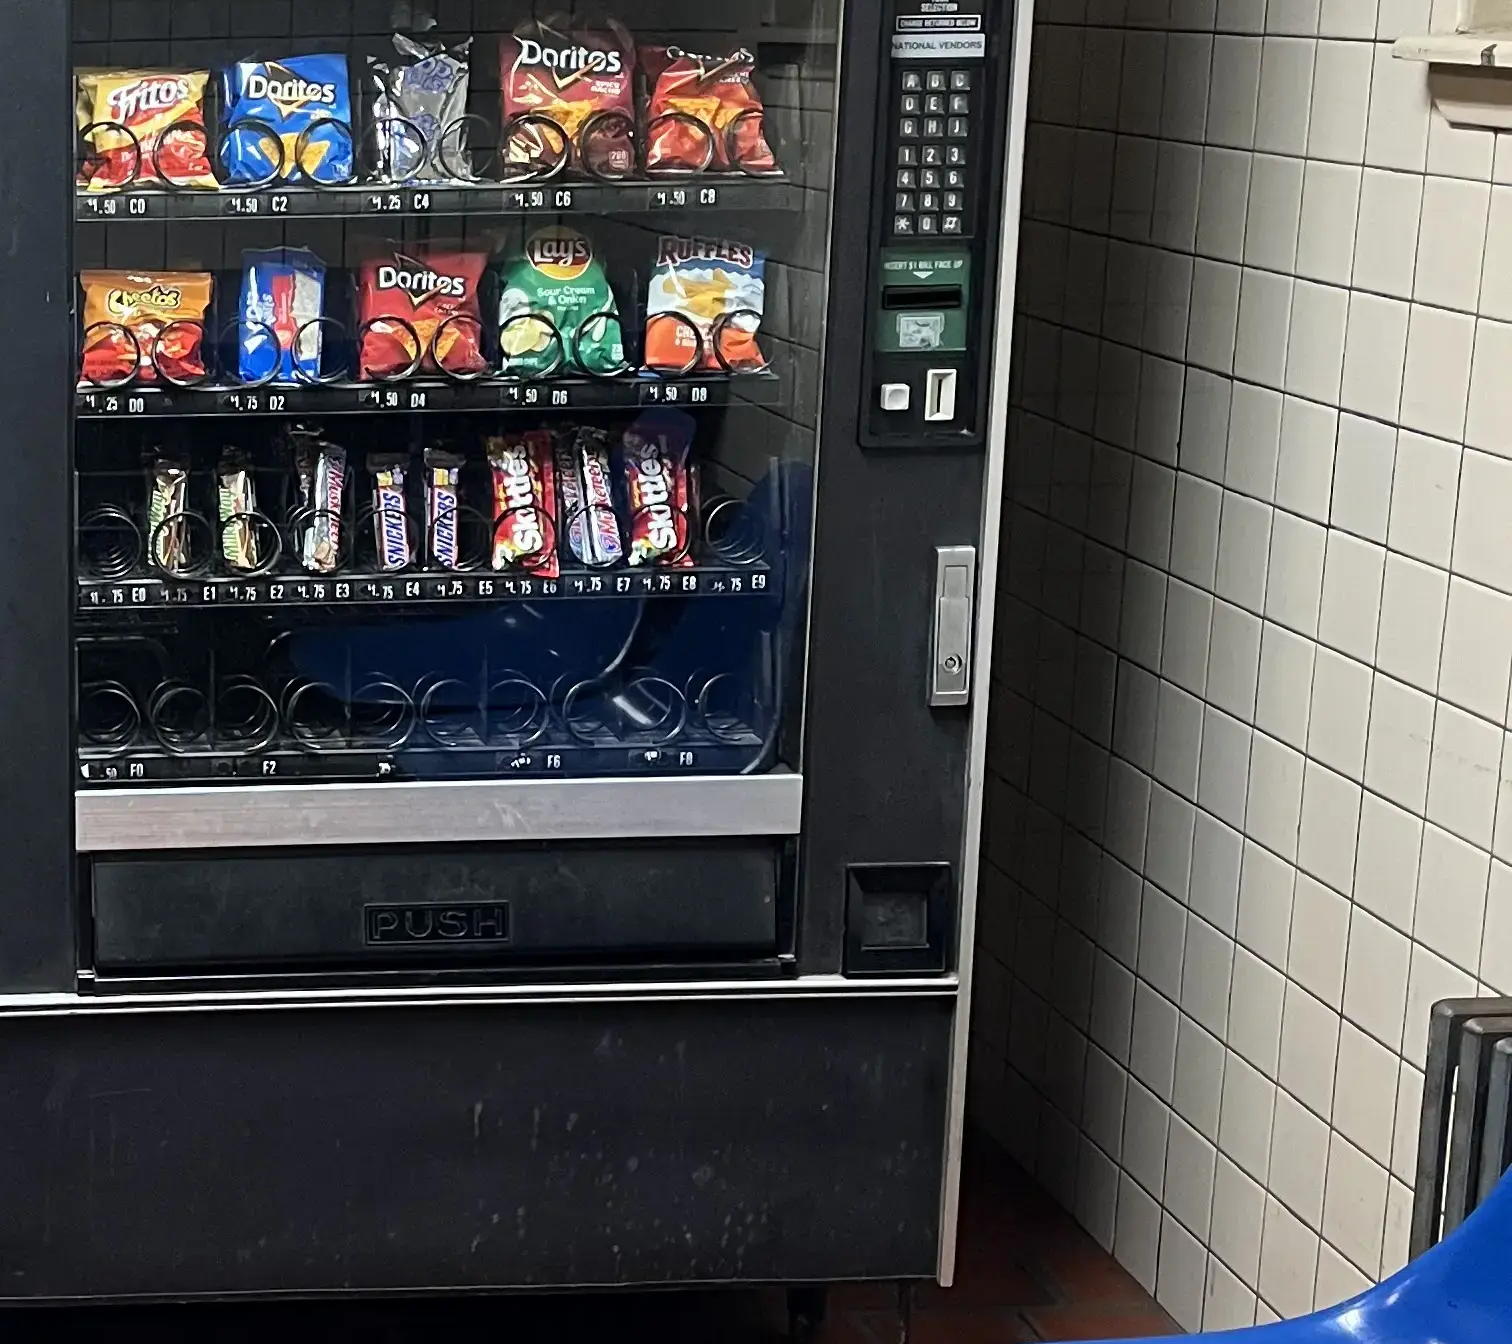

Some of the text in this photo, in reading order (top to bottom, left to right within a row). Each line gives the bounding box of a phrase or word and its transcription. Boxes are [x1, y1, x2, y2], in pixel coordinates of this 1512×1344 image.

[939, 41, 982, 50] VENDORS
[519, 39, 622, 74] Doritos
[906, 74, 916, 88] A
[956, 74, 964, 87] C
[248, 74, 336, 104] Doritos
[106, 76, 190, 123] Fritos
[930, 96, 938, 110] E
[954, 97, 961, 110] F
[954, 120, 960, 134] J
[904, 149, 910, 162] 1
[926, 148, 935, 162] 2
[950, 148, 958, 162] 3
[901, 171, 909, 184] 4
[925, 170, 934, 184] 5
[950, 170, 958, 184] 6
[413, 193, 430, 210] C4
[556, 190, 571, 206] C6
[700, 188, 716, 204] C8
[900, 194, 908, 207] 7
[924, 194, 932, 207] 8
[948, 194, 956, 207] 9
[129, 198, 146, 214] C0
[272, 196, 288, 212] C2
[656, 236, 754, 269] RUFFLES
[379, 265, 466, 296] Doritos
[536, 286, 596, 297] Sour Cream
[108, 286, 181, 317] Cheetos
[558, 294, 586, 305] Onion
[505, 444, 543, 552] Skittles
[638, 442, 678, 550] Skittles
[382, 491, 407, 567] SNICKERS
[437, 491, 455, 567] SNICKERS
[478, 580, 493, 595] E5
[543, 578, 556, 594] E6
[616, 577, 630, 592] E7
[682, 576, 696, 590] E8
[752, 574, 766, 589] E9
[132, 588, 146, 602] E0
[203, 586, 216, 600] E1
[270, 584, 284, 599] E2
[336, 584, 350, 598] E3
[406, 582, 420, 596] E4
[262, 760, 276, 774] F2
[548, 755, 560, 769] F6
[130, 763, 144, 777] F0
[372, 908, 503, 939] PUSH
